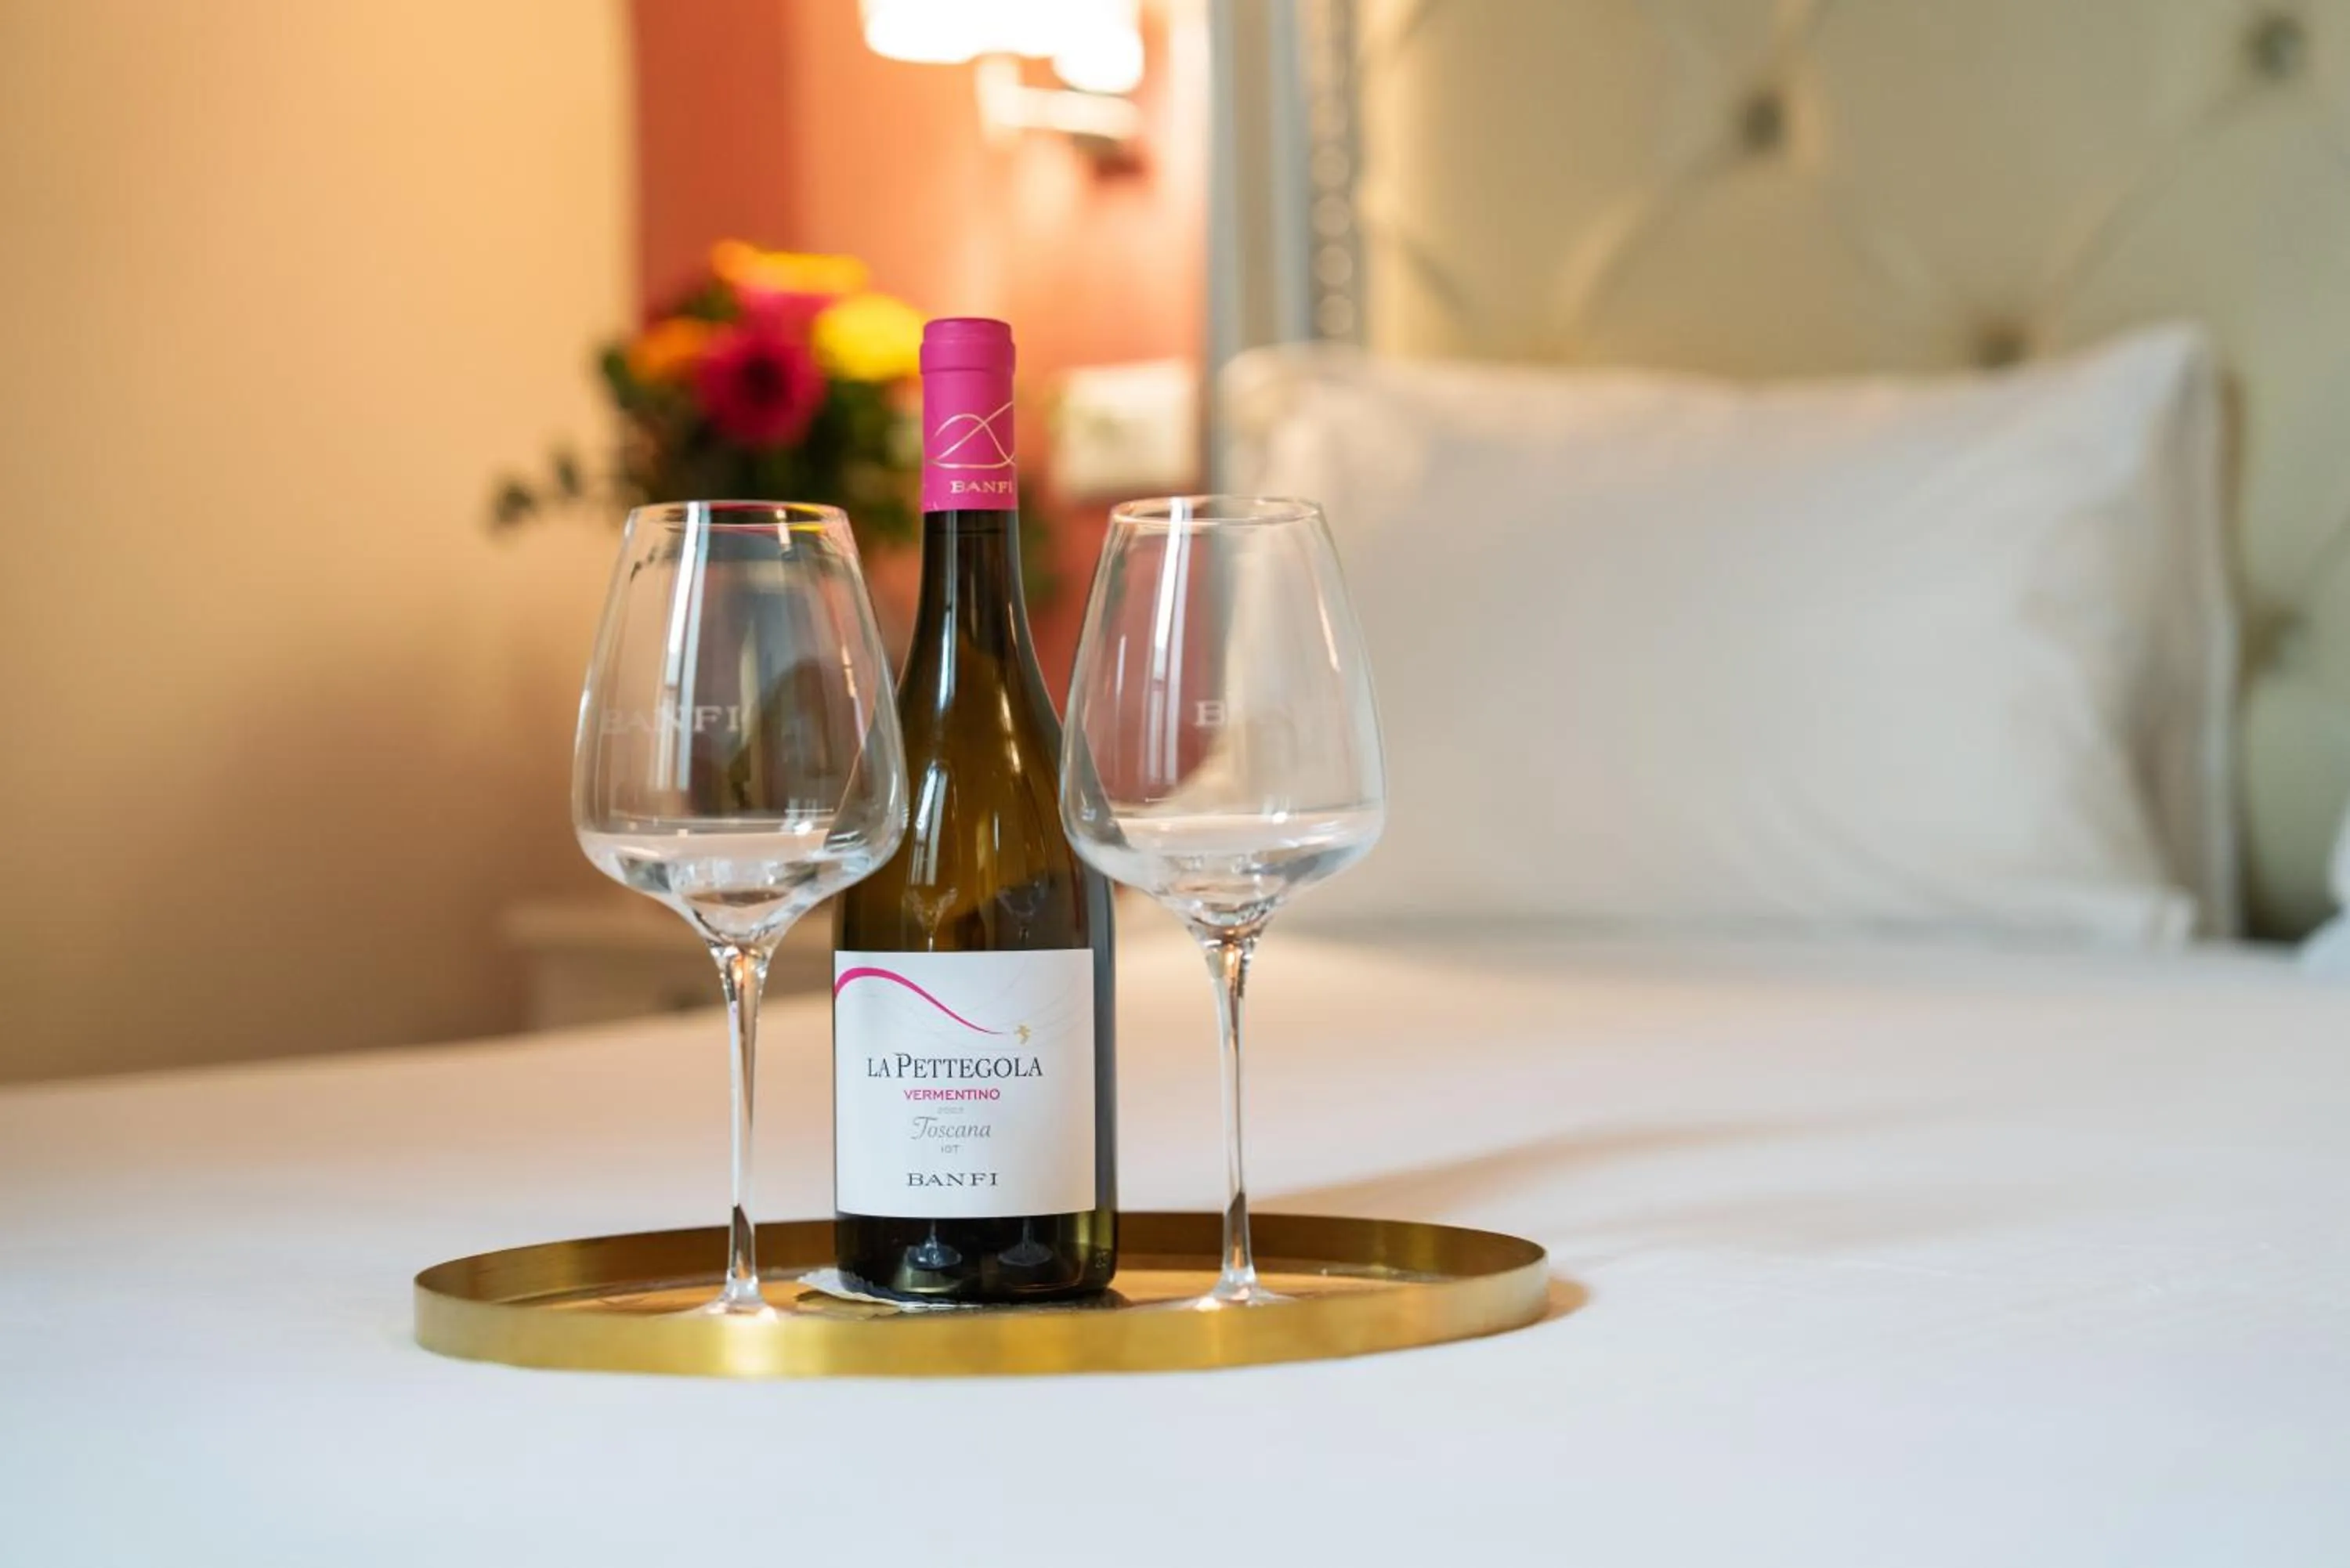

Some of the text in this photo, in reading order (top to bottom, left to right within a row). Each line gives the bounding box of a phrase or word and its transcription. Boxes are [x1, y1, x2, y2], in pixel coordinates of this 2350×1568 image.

[949, 479, 1013, 494] BANFI
[867, 1053, 1043, 1078] LA PETTEGOLA
[903, 1087, 1001, 1101] VERMENTINO
[910, 1116, 992, 1140] Toscana
[907, 1172, 1000, 1187] BANFI
